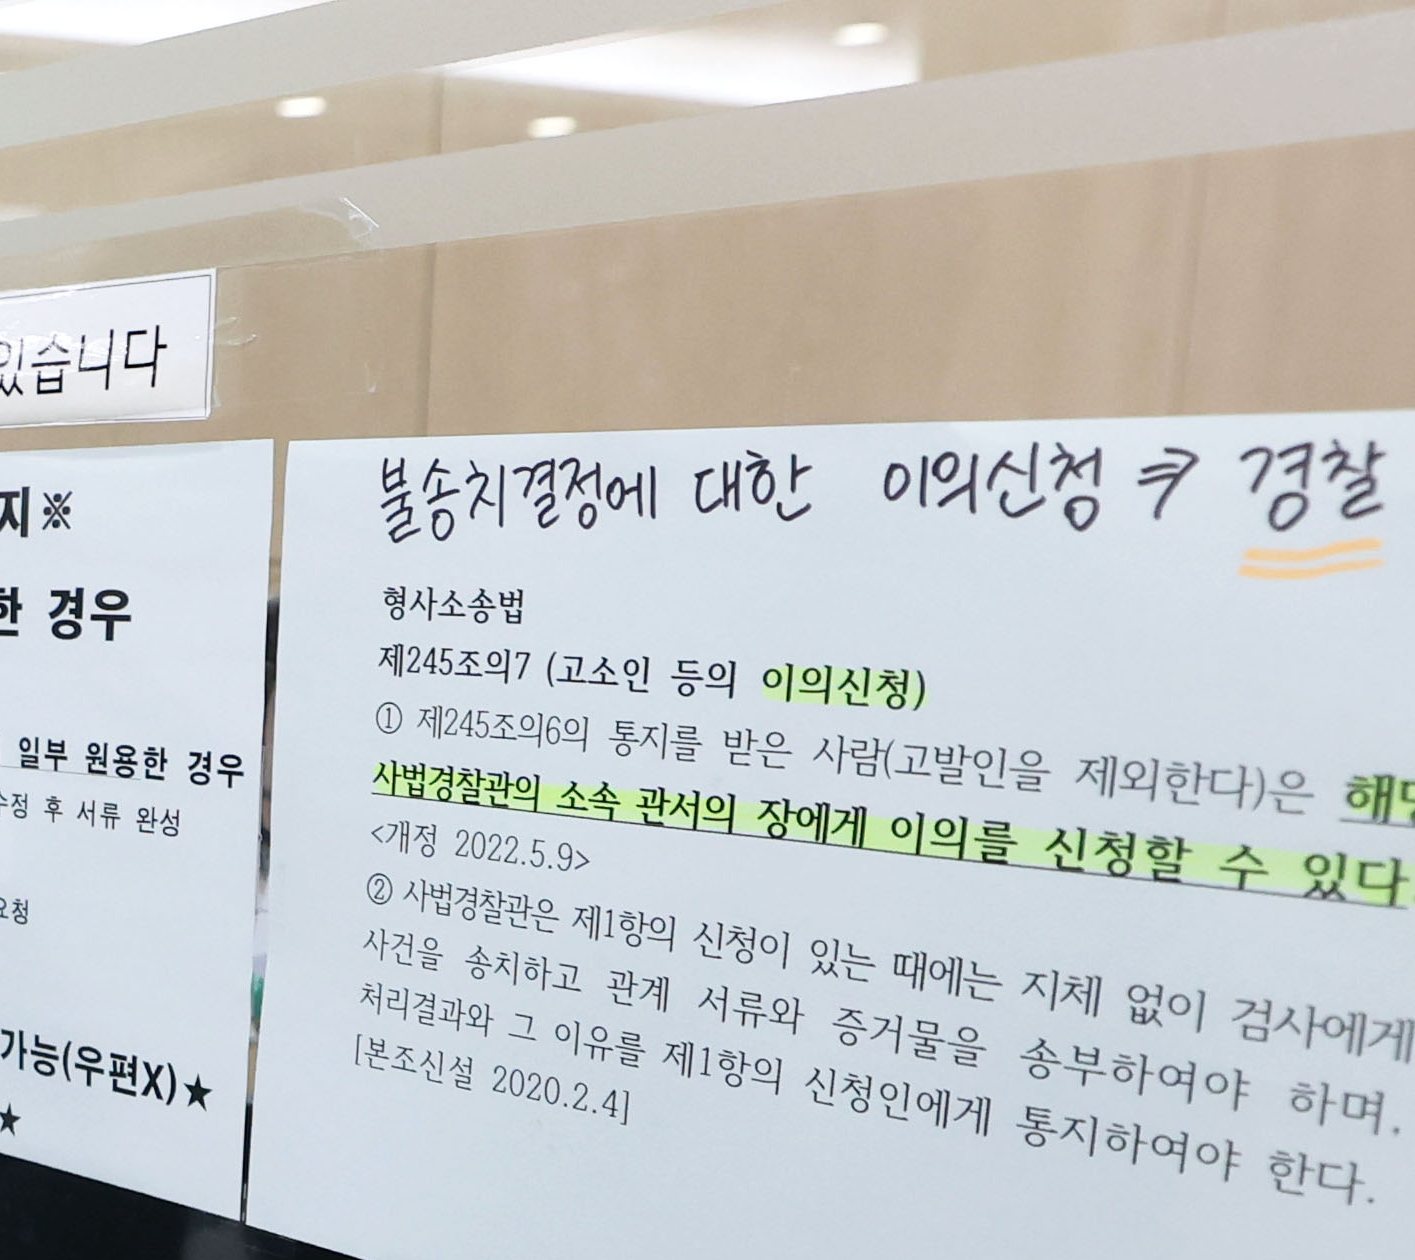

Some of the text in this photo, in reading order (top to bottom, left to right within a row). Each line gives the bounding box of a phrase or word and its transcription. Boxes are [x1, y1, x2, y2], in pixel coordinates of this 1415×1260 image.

[380, 439, 1386, 543] 불송치결정에 대한 이의신청 경찰
[48, 587, 132, 641] 경우
[383, 586, 523, 624] 형사소송법
[378, 643, 925, 711] 제245조의7 (고소인 등의 이의신청)
[19, 737, 68, 772] 일부
[85, 742, 168, 780] 원용한
[188, 751, 244, 789] 경우
[417, 705, 588, 752] 제245조의6의
[608, 720, 703, 762] 통지를
[723, 728, 793, 769] 받은
[813, 735, 1051, 792] 사람(고발인을
[1075, 755, 1314, 814] 제외한다)은
[44, 796, 63, 823] 후
[77, 800, 121, 830] 서류
[136, 807, 179, 837] 완성
[371, 820, 437, 858] <개정
[373, 759, 540, 812] 사법경찰관의
[555, 781, 621, 821] 소속
[636, 785, 736, 834] 관서의
[757, 799, 868, 849] 장에게
[891, 810, 1018, 865] 이의를
[1046, 826, 1192, 883] 신청할
[1219, 845, 1269, 891] 수
[403, 879, 560, 933] 사법경찰관은
[572, 905, 675, 952] 제1항의
[693, 922, 789, 970] 신청이
[811, 938, 876, 983] 있는
[894, 951, 1003, 1002] 때에는
[1021, 969, 1102, 1018] 지체
[1127, 984, 1205, 1033] 없이
[1232, 999, 1415, 1064] 검사에게
[363, 928, 443, 971] 사건을
[465, 945, 581, 992] 송치하고
[607, 970, 669, 1013] 관계
[698, 985, 805, 1035] 서류와
[832, 1008, 987, 1068] 증거물을
[1020, 1038, 1250, 1112] 송부하여야
[0, 1028, 176, 1106] 가능(우편X)
[355, 1034, 472, 1091] [본조신설
[360, 982, 1374, 1205] 처리결과와 그 이유를 제1항의 신청인에게 통지하여야 한다.
